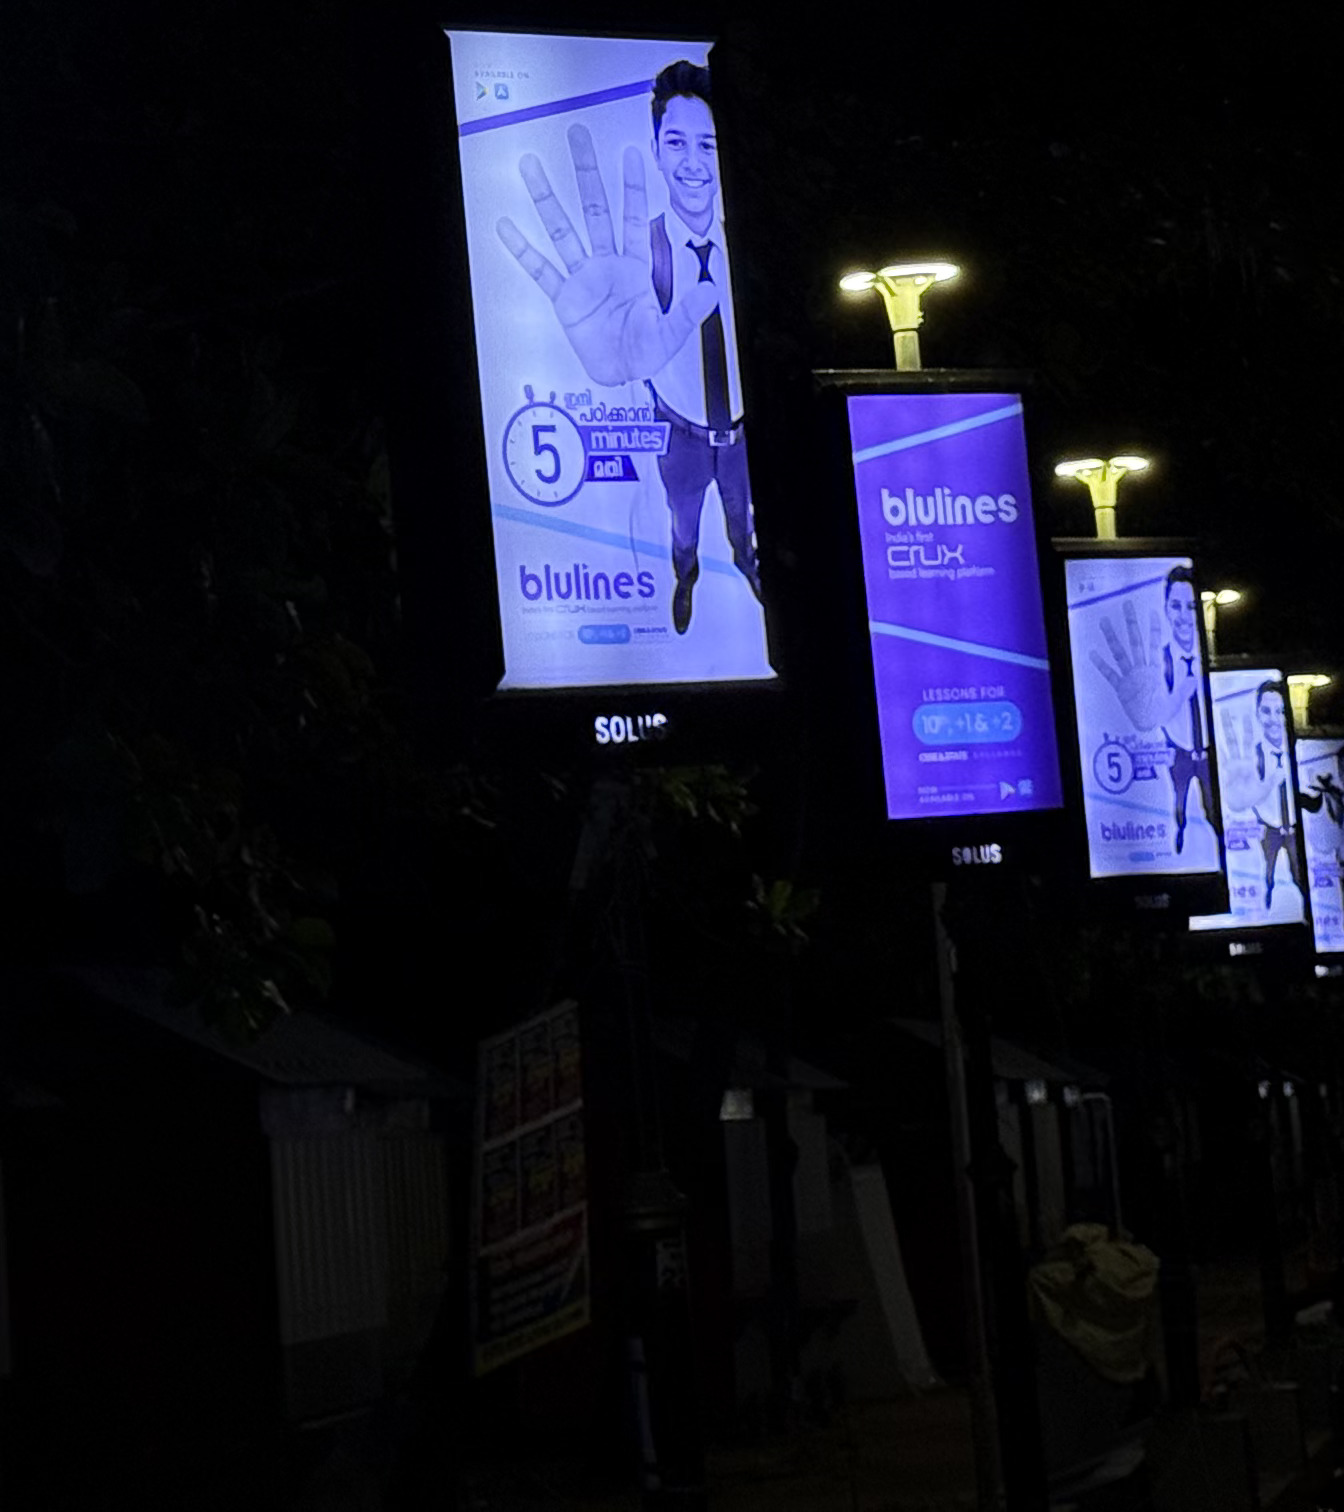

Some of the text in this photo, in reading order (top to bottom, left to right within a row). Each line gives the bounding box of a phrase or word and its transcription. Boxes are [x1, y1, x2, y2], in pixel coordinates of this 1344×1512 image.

[591, 426, 663, 450] minutes
[531, 425, 561, 484] 5
[880, 487, 1019, 526] blulines
[520, 563, 656, 601] blulines
[922, 687, 977, 702] LESSONS
[1107, 752, 1122, 783] 5
[952, 843, 1002, 866] SOLUS
